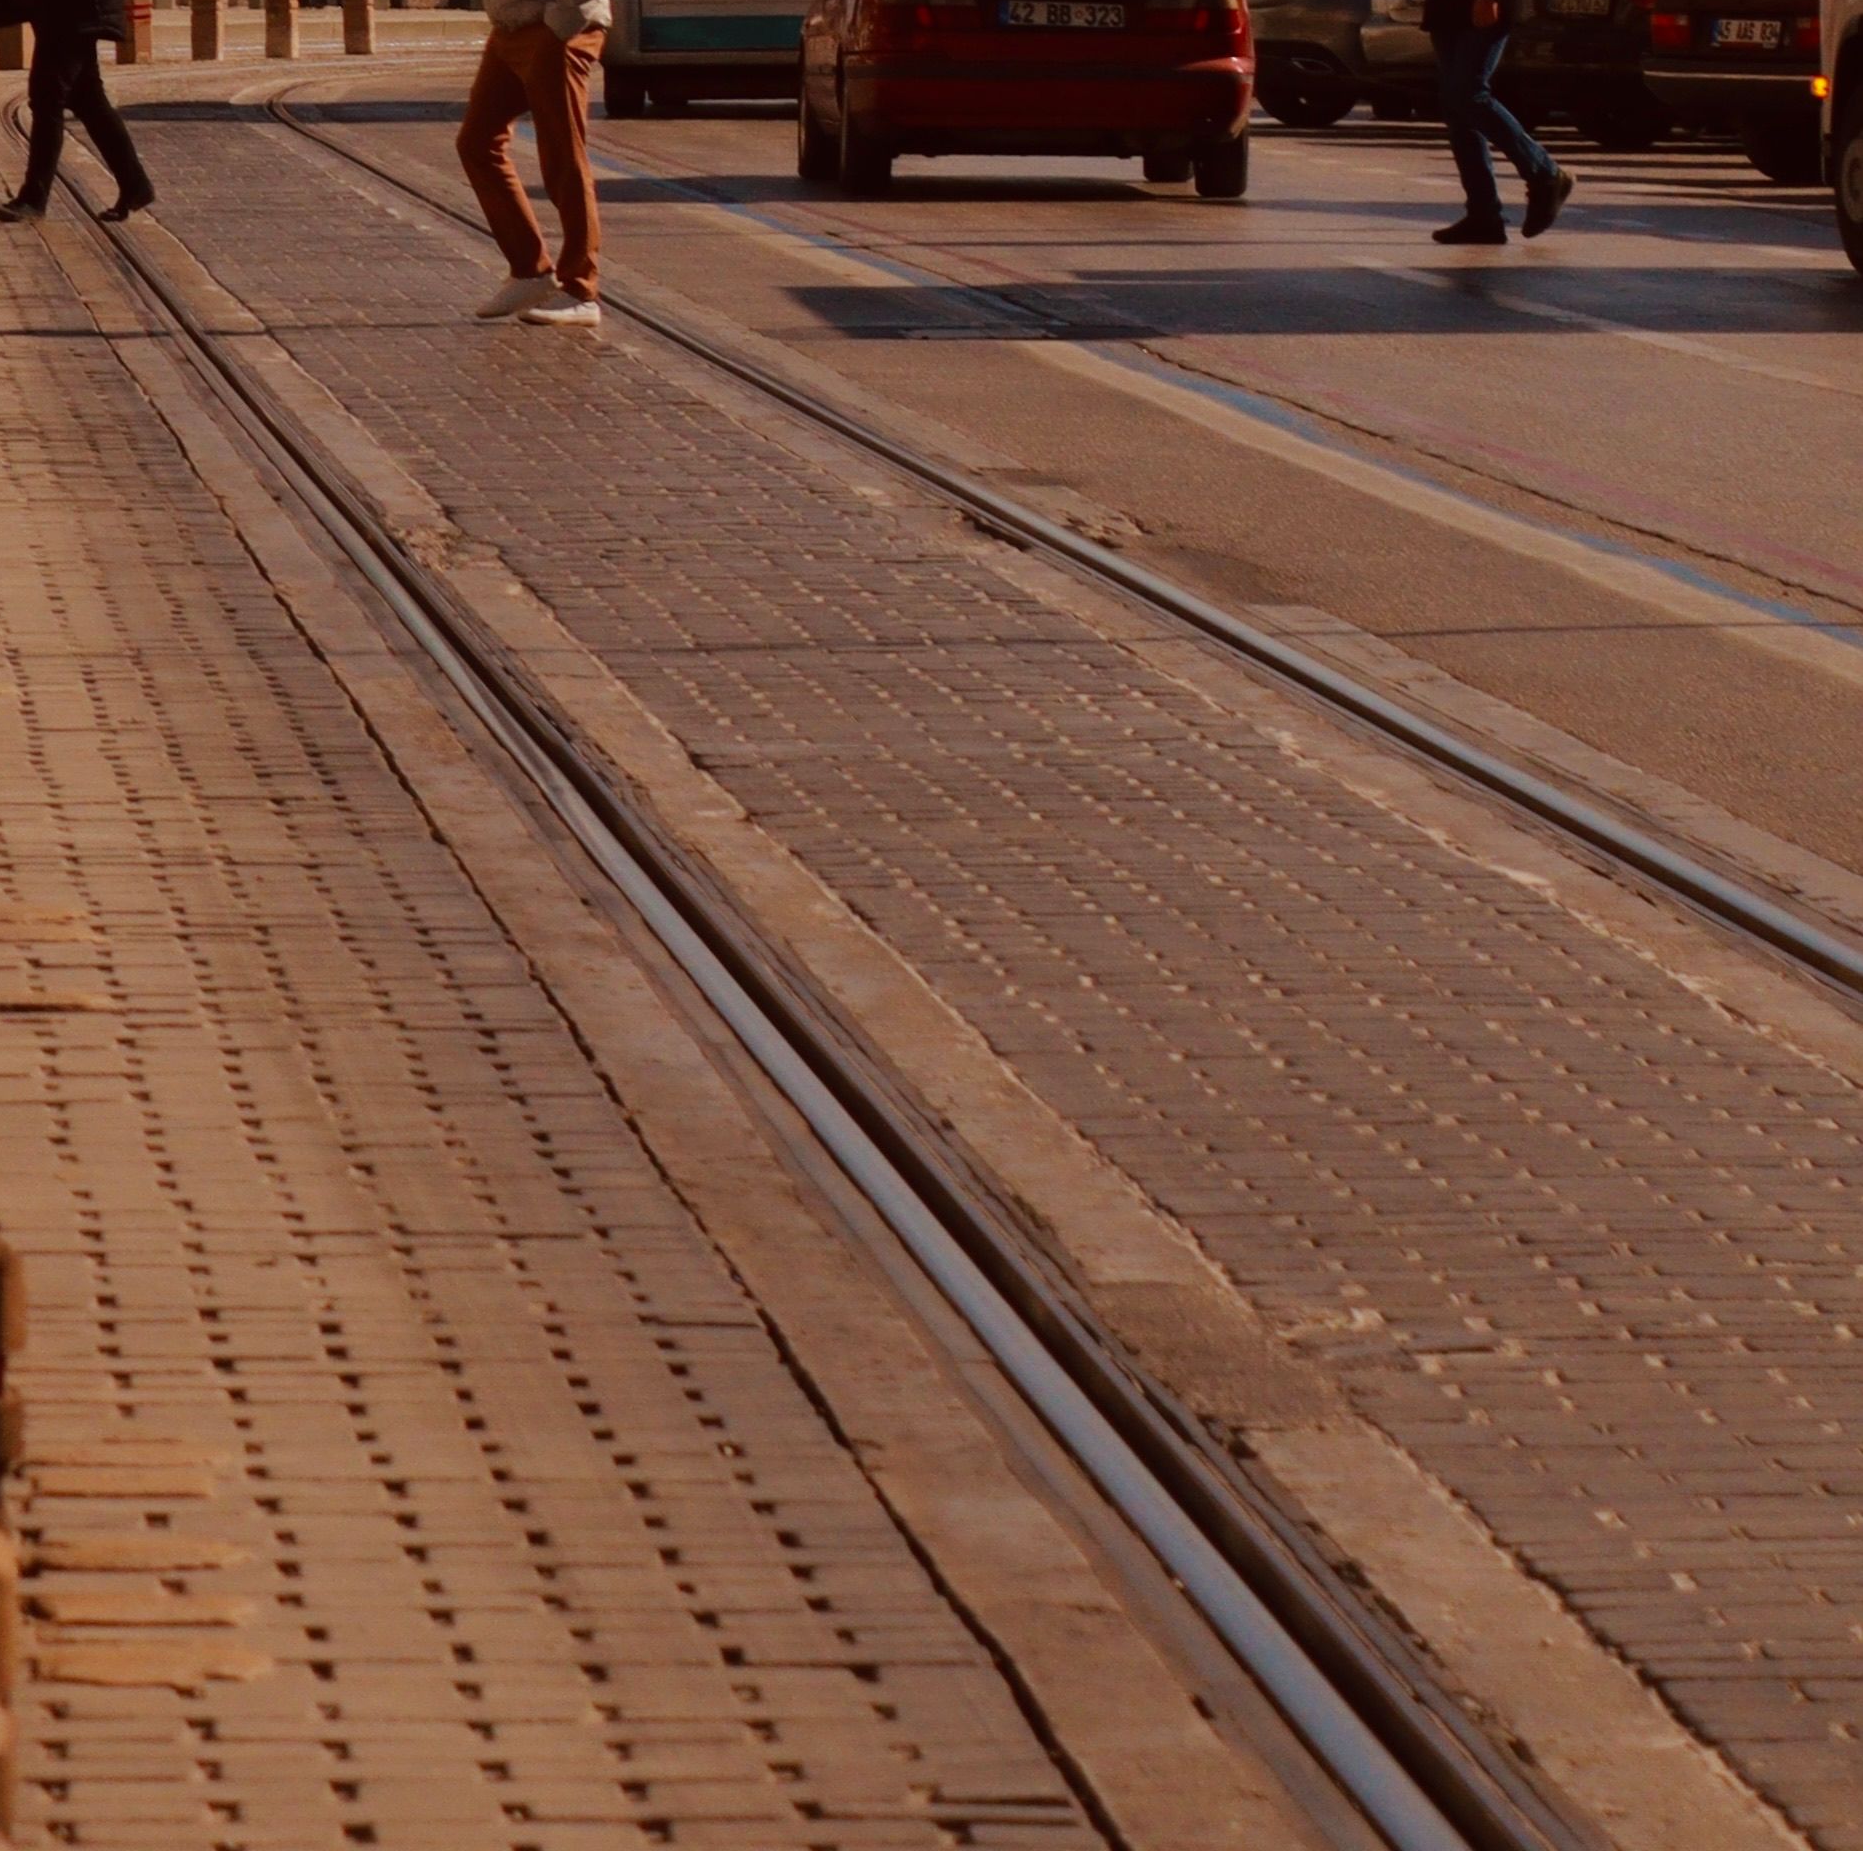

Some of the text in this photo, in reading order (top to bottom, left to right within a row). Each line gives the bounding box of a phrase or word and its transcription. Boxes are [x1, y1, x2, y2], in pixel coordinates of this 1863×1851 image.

[1010, 2, 1124, 27] 42 BB 323
